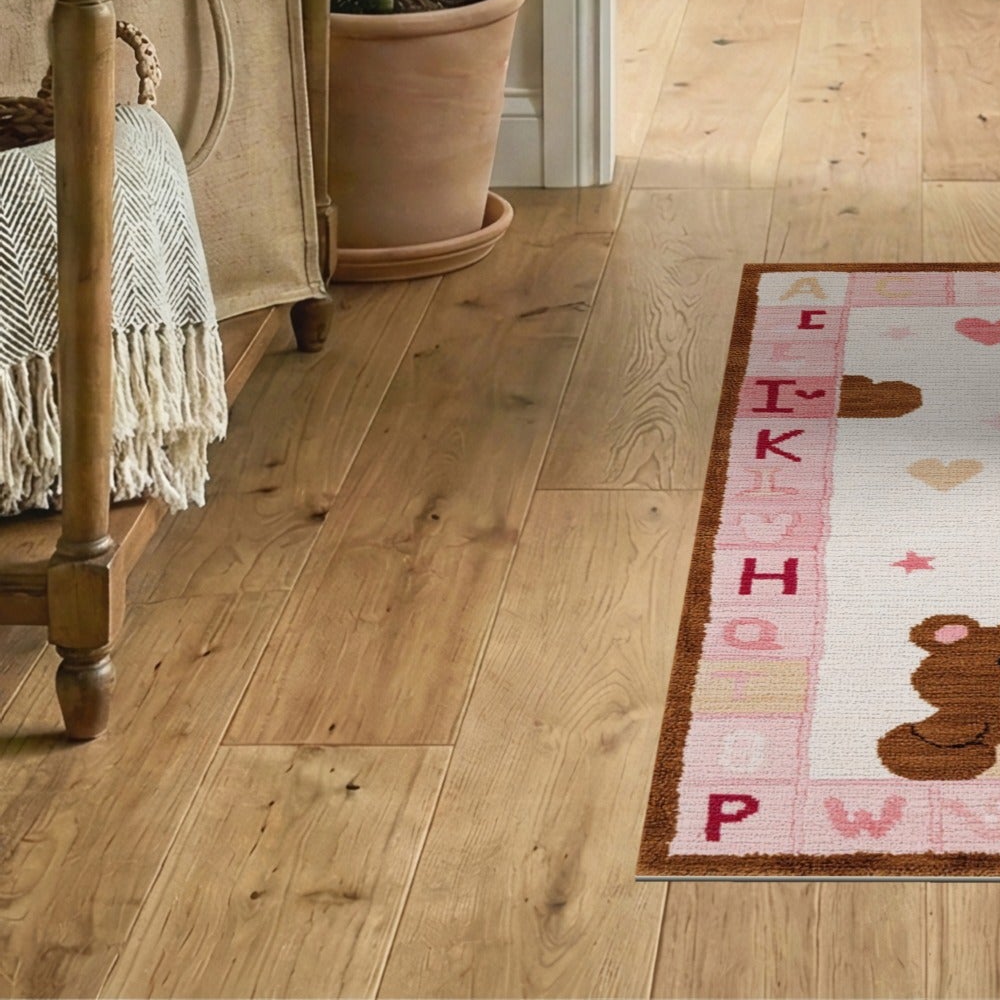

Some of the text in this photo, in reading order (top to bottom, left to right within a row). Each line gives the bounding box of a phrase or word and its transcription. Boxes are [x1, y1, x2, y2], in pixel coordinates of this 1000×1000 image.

[756, 429, 805, 463] K
[738, 557, 799, 595] H
[705, 794, 760, 842] P
[824, 795, 907, 839] W
